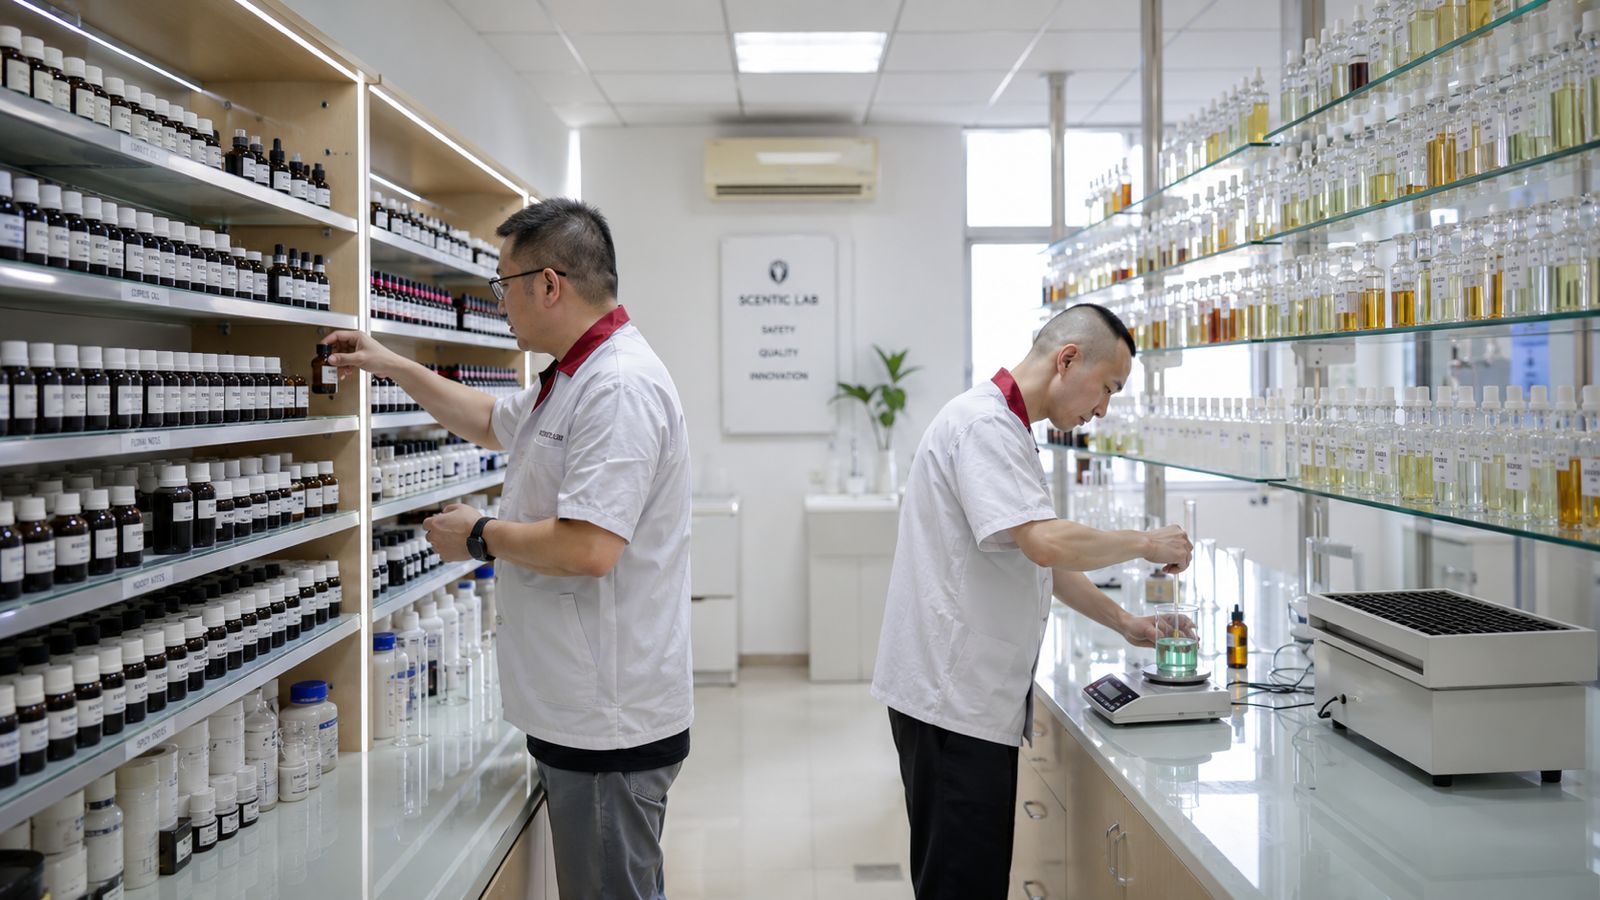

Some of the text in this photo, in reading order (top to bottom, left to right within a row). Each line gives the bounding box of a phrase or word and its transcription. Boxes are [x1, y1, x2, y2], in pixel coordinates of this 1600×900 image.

[739, 295, 819, 306] SCENTIC LAB
[762, 325, 795, 334] SAFETY
[759, 349, 798, 358] QUALITY
[750, 372, 808, 380] INNOVATION
